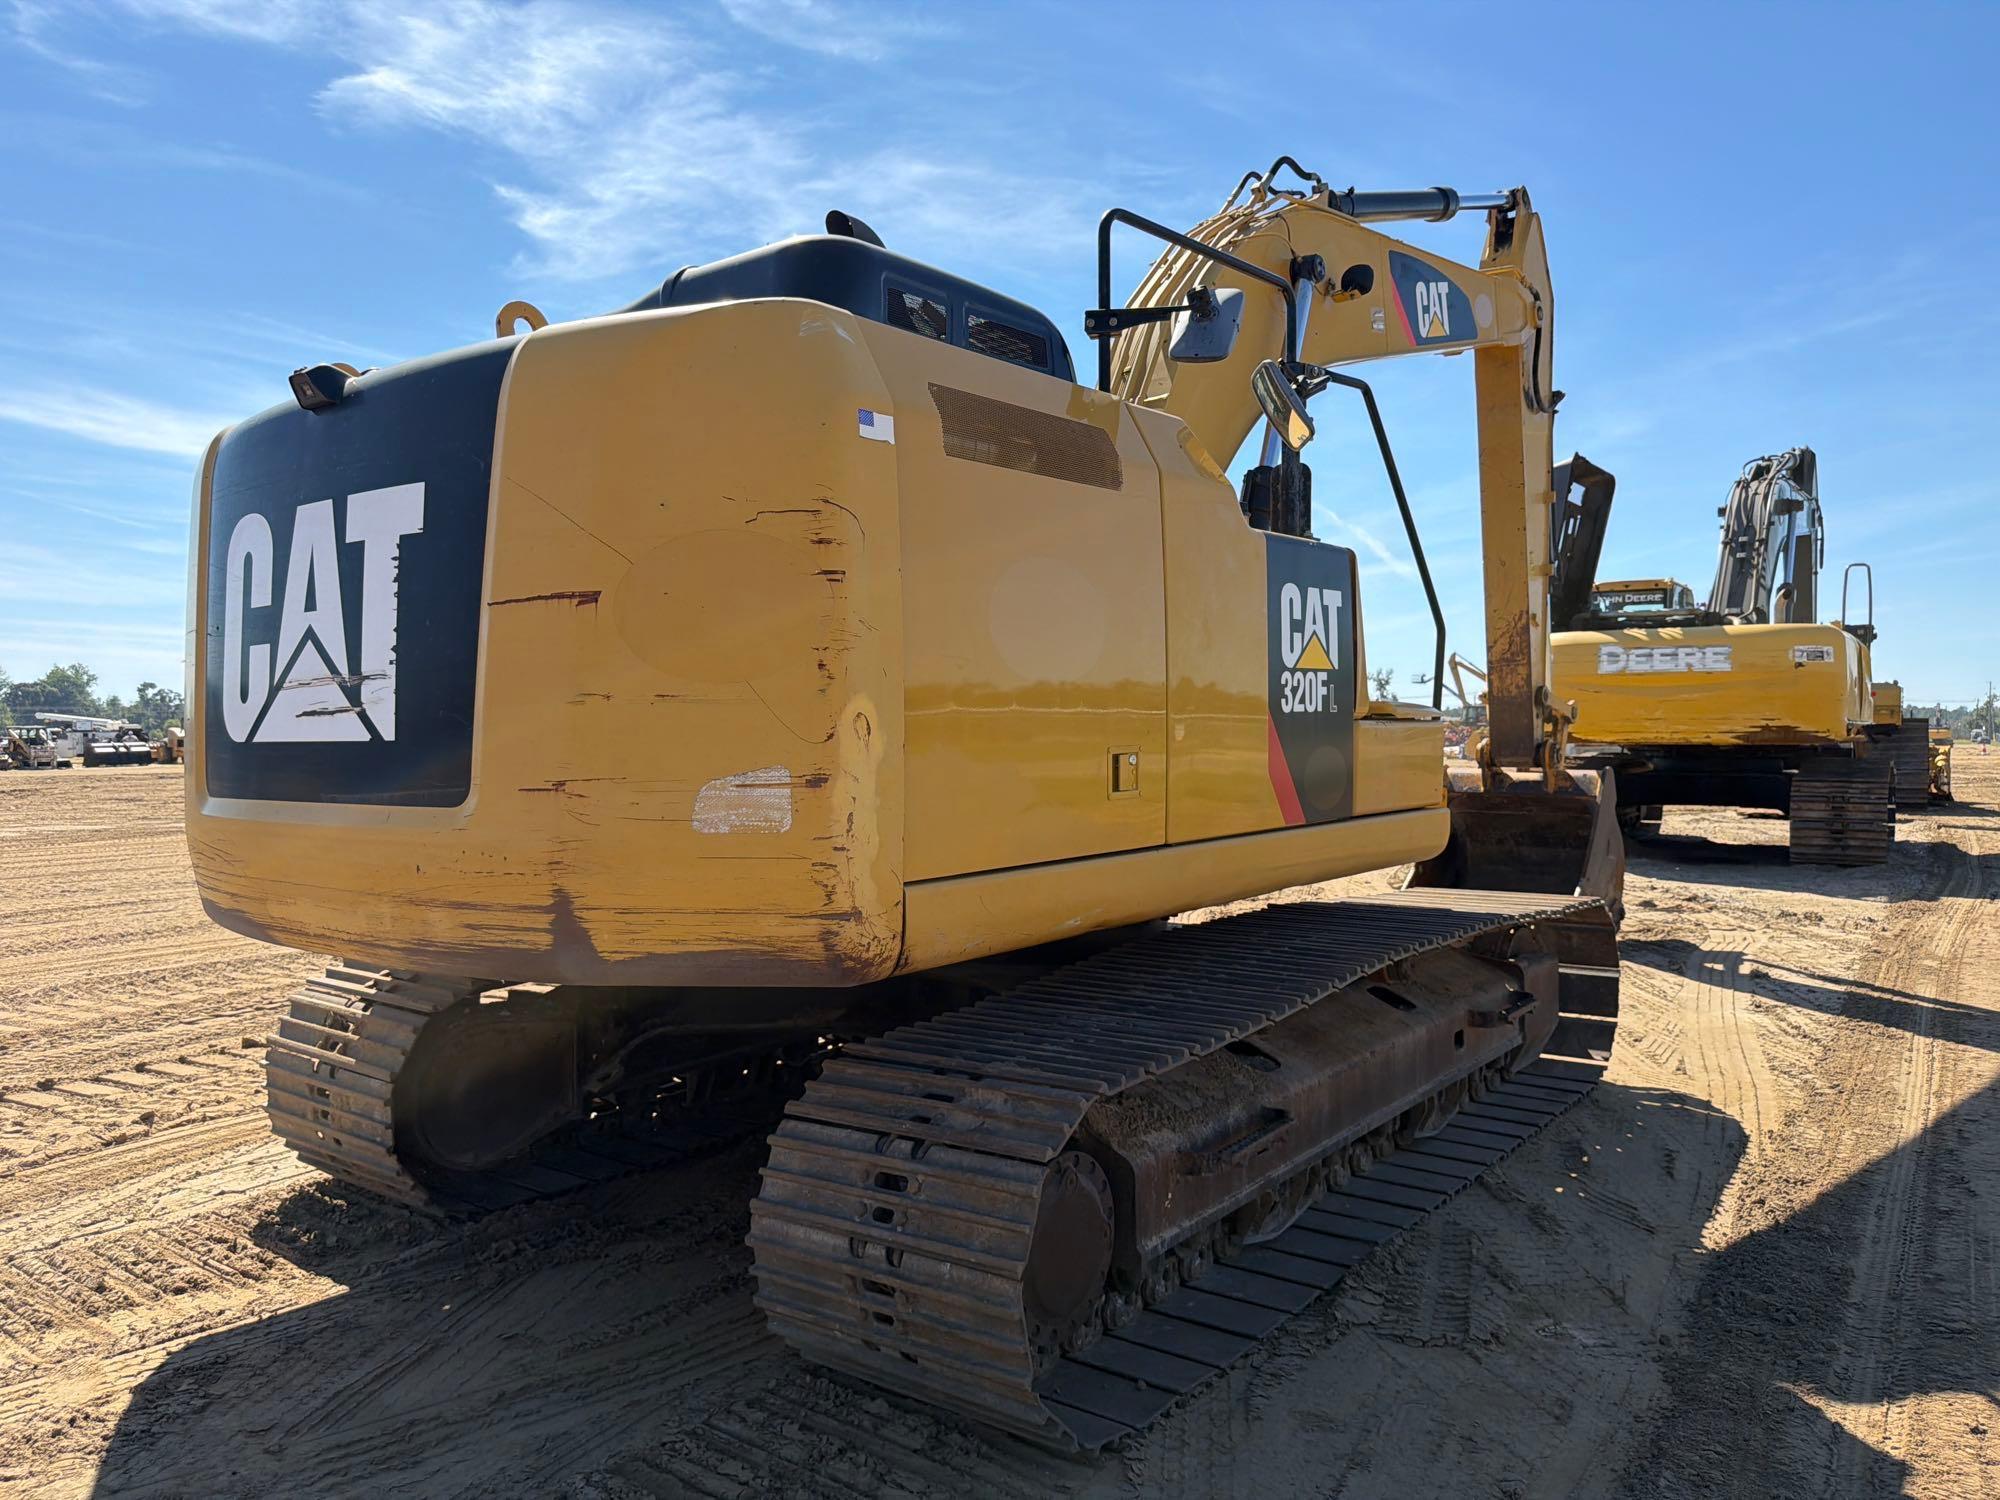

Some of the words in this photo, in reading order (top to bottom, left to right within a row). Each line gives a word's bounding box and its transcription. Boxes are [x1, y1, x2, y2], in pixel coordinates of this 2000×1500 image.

[1415, 281, 1449, 338] CAT
[222, 481, 425, 743] CAT
[1625, 594, 1664, 602] DEERE
[1280, 582, 1342, 670] CAT
[1598, 645, 1732, 674] DEERE
[1280, 671, 1328, 713] 320F
